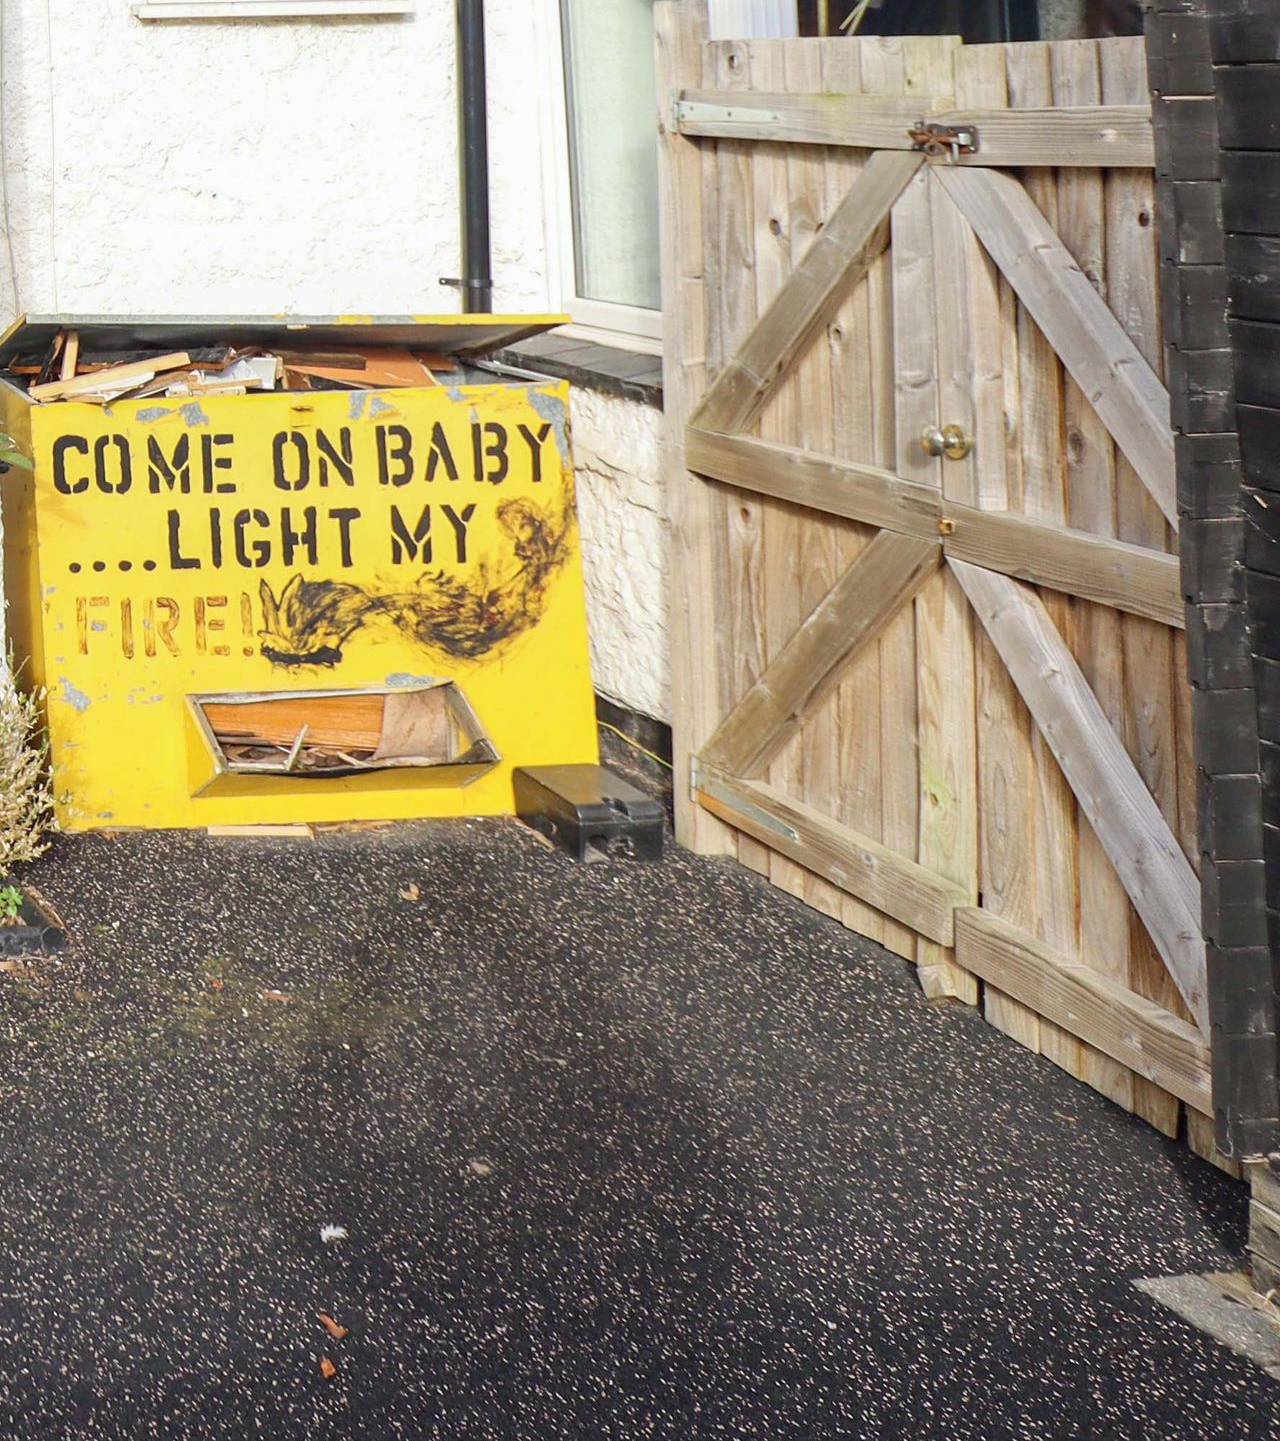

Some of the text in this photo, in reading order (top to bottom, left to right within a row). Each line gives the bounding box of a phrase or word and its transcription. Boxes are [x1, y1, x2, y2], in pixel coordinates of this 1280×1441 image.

[51, 421, 553, 495] COME ON BABY
[390, 503, 477, 565] MY
[75, 592, 255, 660] FIRE!
